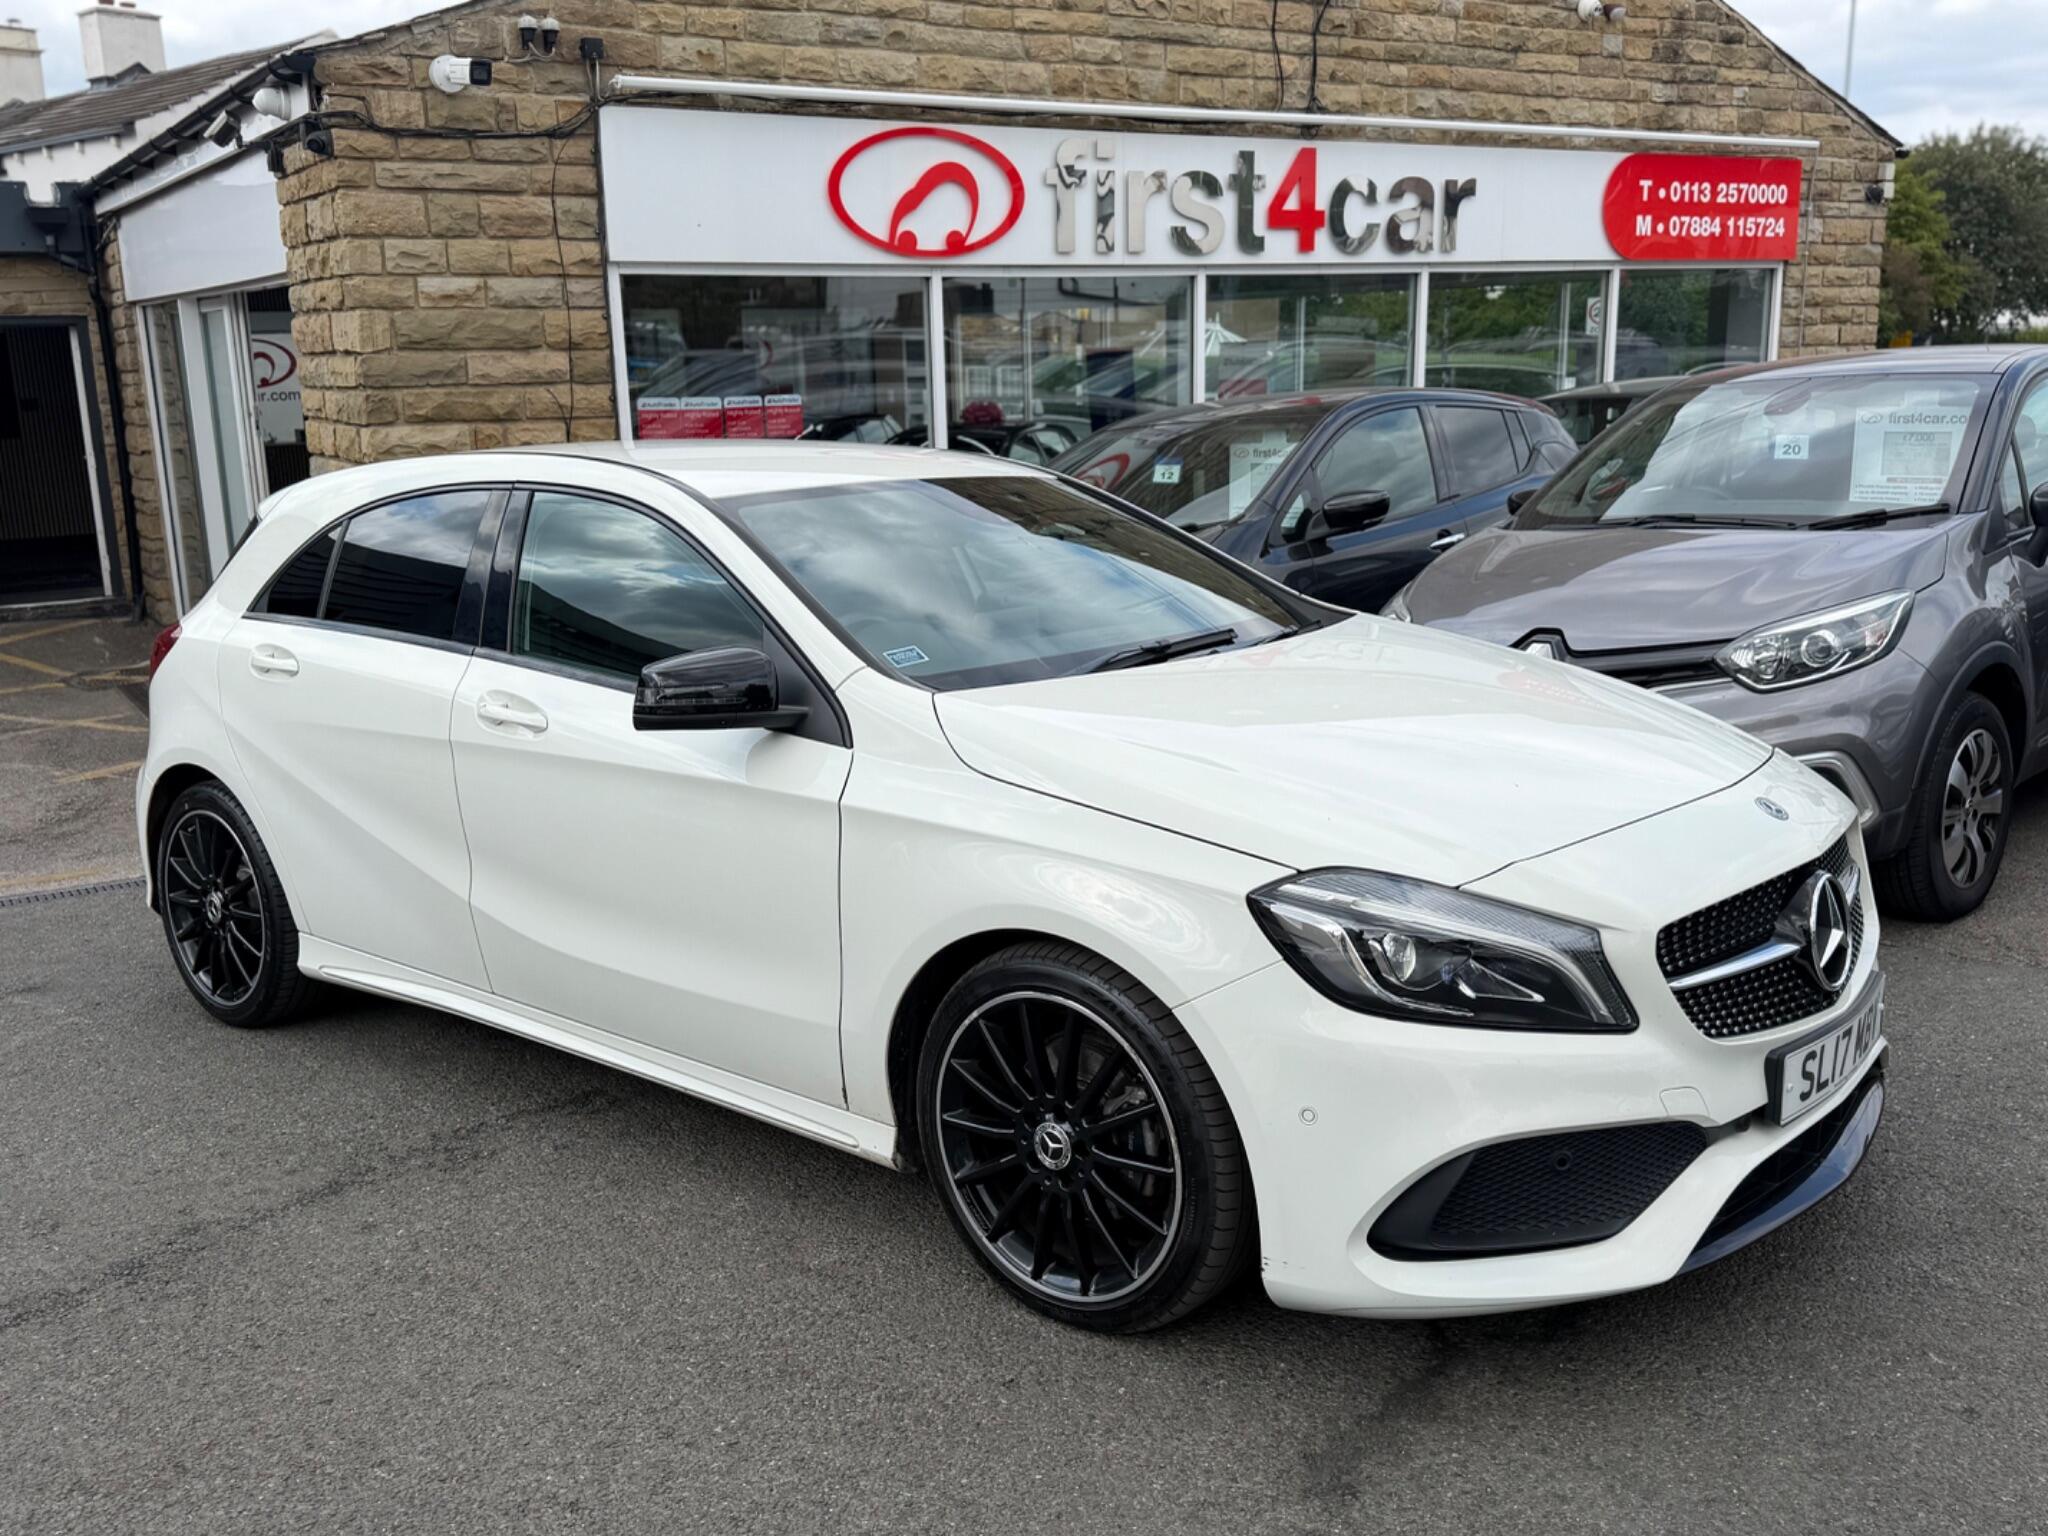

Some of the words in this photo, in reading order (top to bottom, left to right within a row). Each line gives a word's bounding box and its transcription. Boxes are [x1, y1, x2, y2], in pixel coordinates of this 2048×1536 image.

[1045, 137, 1477, 255] first4car
[1639, 180, 1653, 202] T
[1669, 181, 1711, 203] 0113
[1716, 183, 1788, 205] 2570000
[1635, 215, 1652, 237] M
[1669, 216, 1721, 237] 07884
[1727, 217, 1785, 238] 115724
[1782, 444, 1801, 456] 20
[1160, 471, 1174, 480] 12
[1799, 1025, 1853, 1102] SL17
